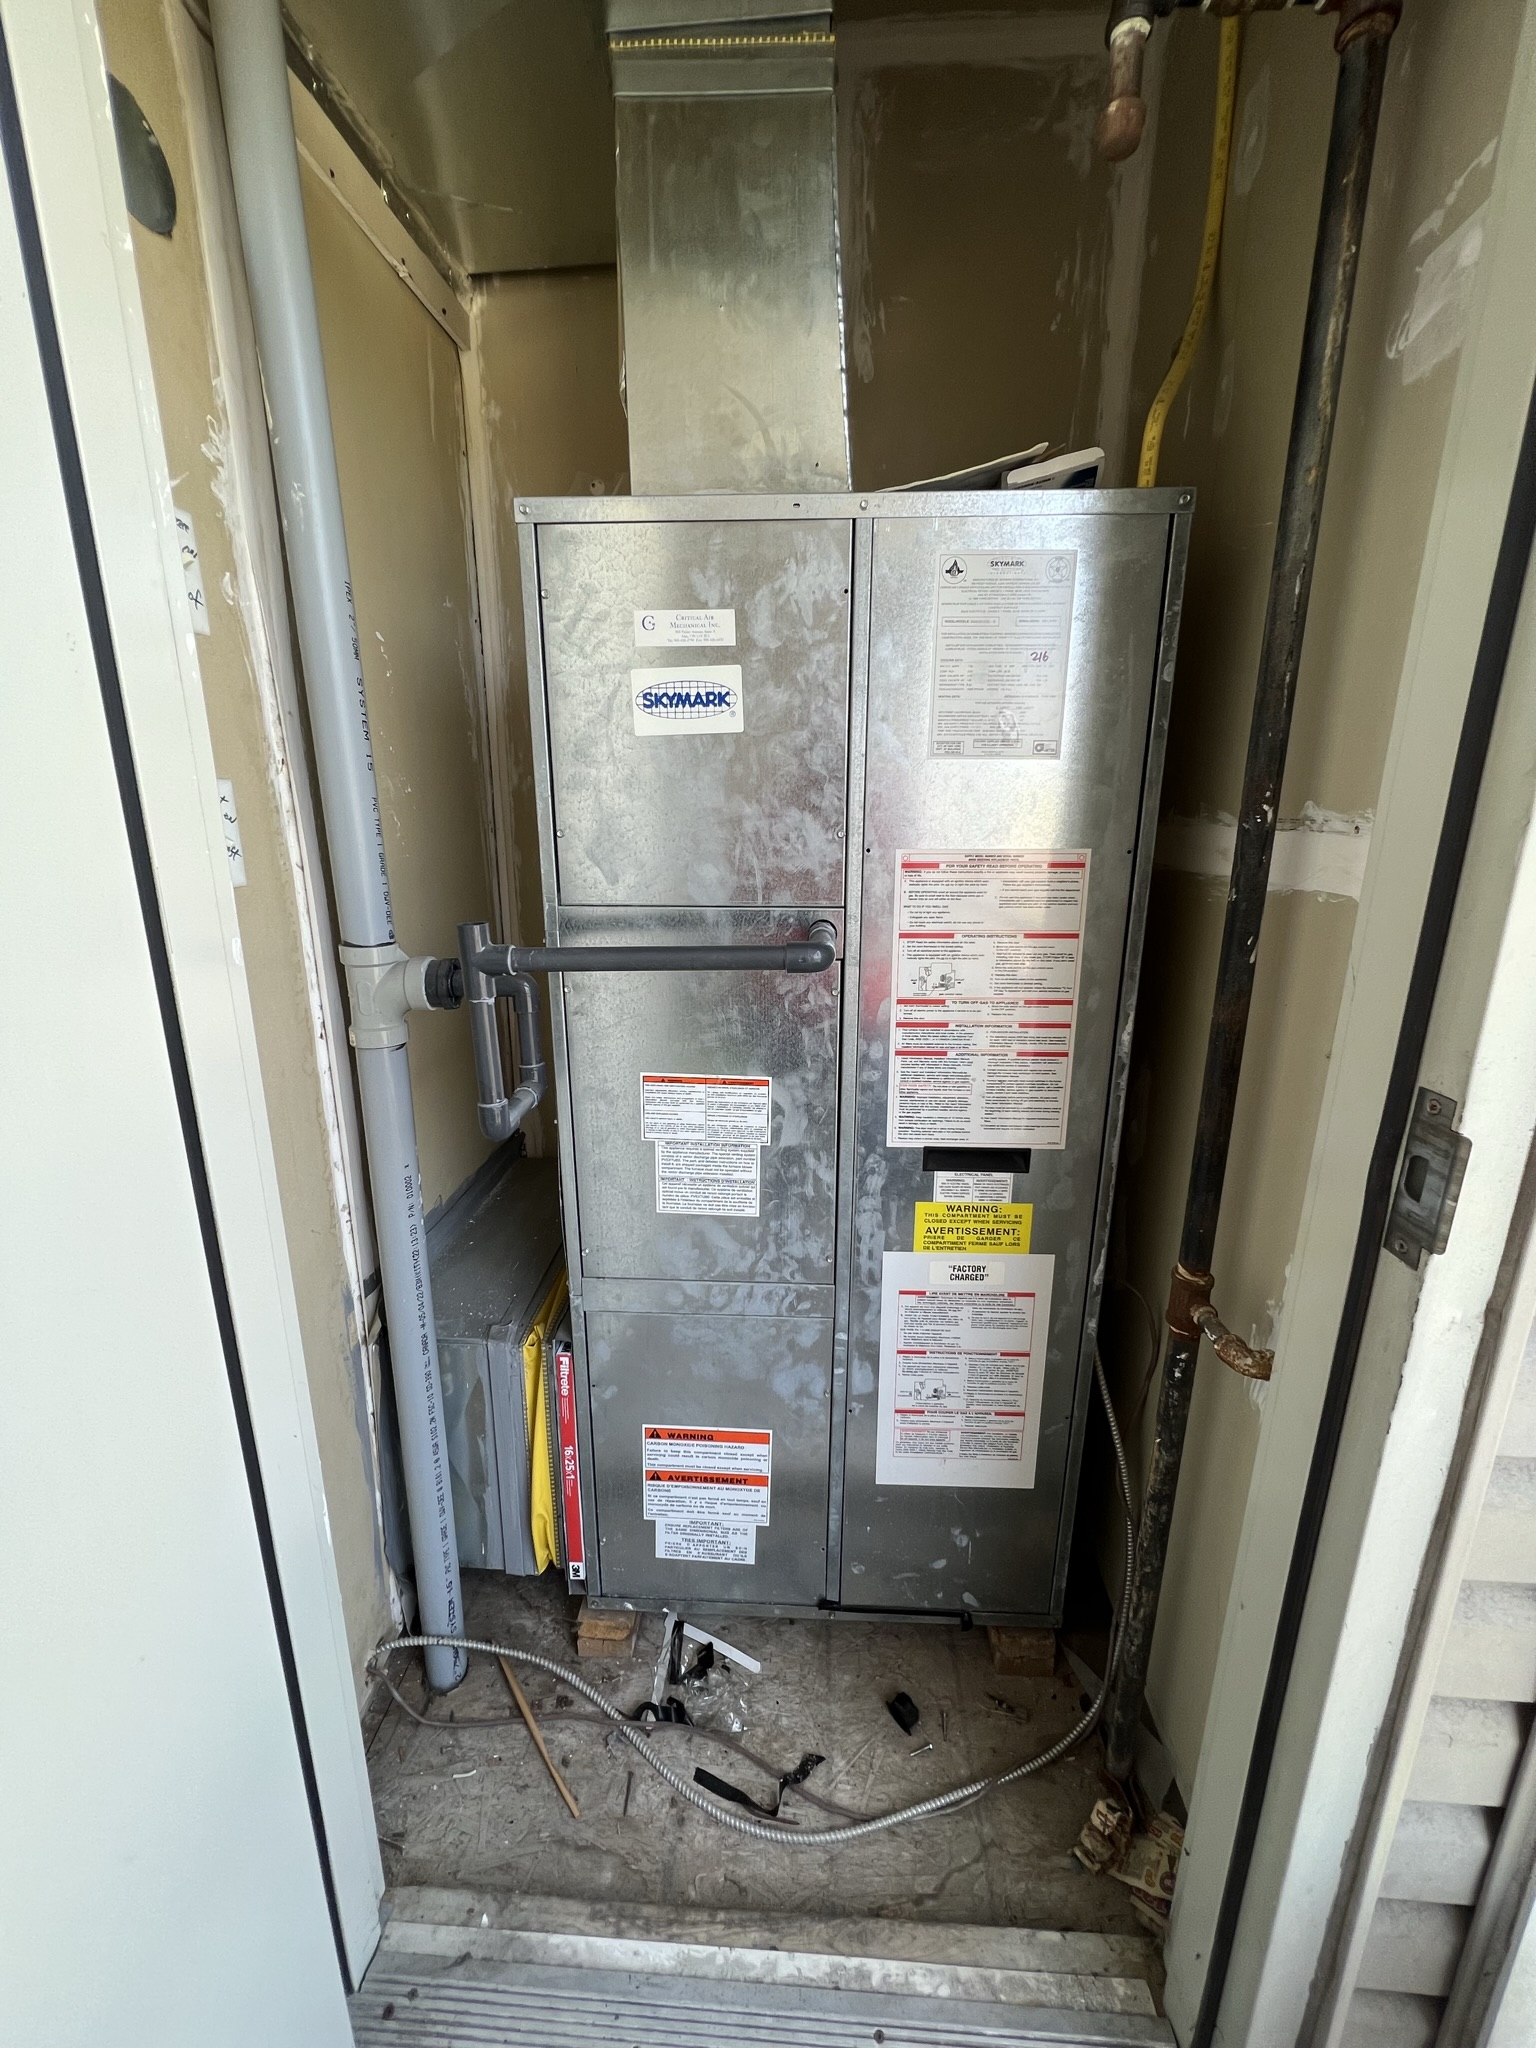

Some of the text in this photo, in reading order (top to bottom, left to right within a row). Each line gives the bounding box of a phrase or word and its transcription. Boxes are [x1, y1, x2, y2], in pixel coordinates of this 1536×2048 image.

[1030, 651, 1048, 662] 216
[642, 692, 730, 708] SKYMARK
[357, 677, 370, 741] SYSTEM
[946, 1205, 1002, 1213] WARNING:
[925, 1227, 1020, 1235] AVERTISSEMENT:
[560, 1356, 570, 1396] Filtrete
[667, 1432, 714, 1440] WARNING
[564, 1445, 575, 1480] 16x25x1
[667, 1475, 748, 1485] AVERTISSEMENT
[572, 1564, 580, 1578] 3M
